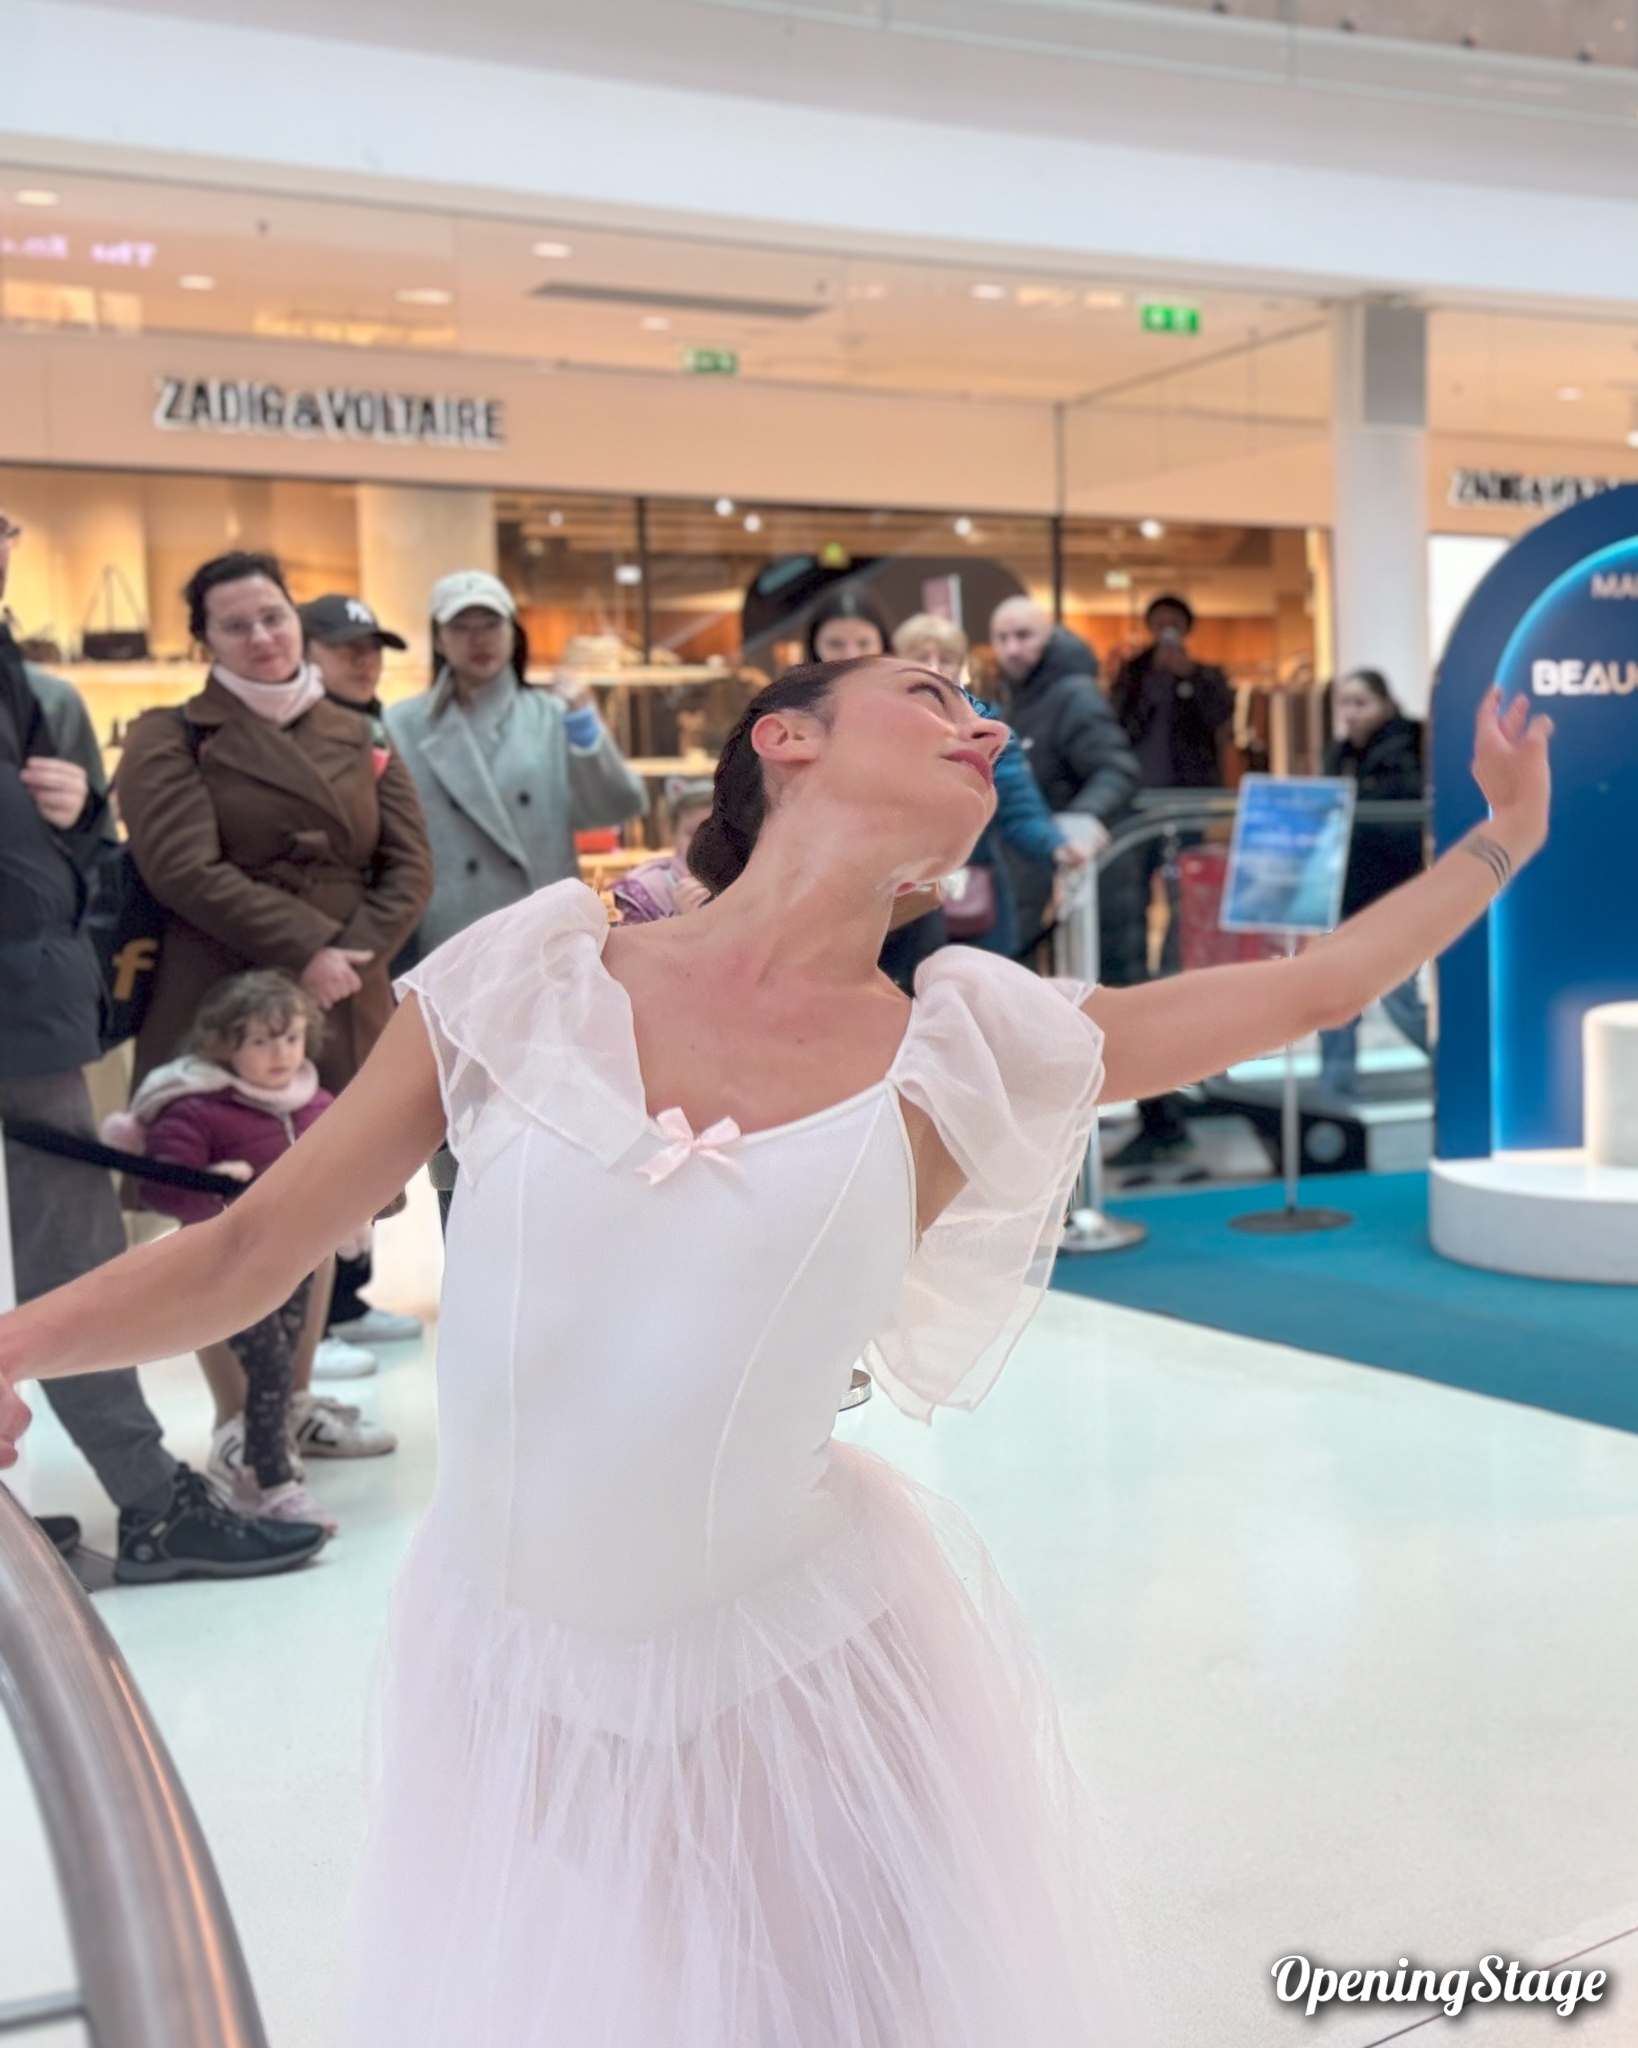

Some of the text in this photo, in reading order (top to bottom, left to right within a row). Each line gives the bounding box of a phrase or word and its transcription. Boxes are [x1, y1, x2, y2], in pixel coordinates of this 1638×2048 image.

[154, 377, 504, 447] ZADIG&VOLTAIRE
[1591, 573, 1638, 599] MA
[1531, 659, 1638, 696] BEAU
